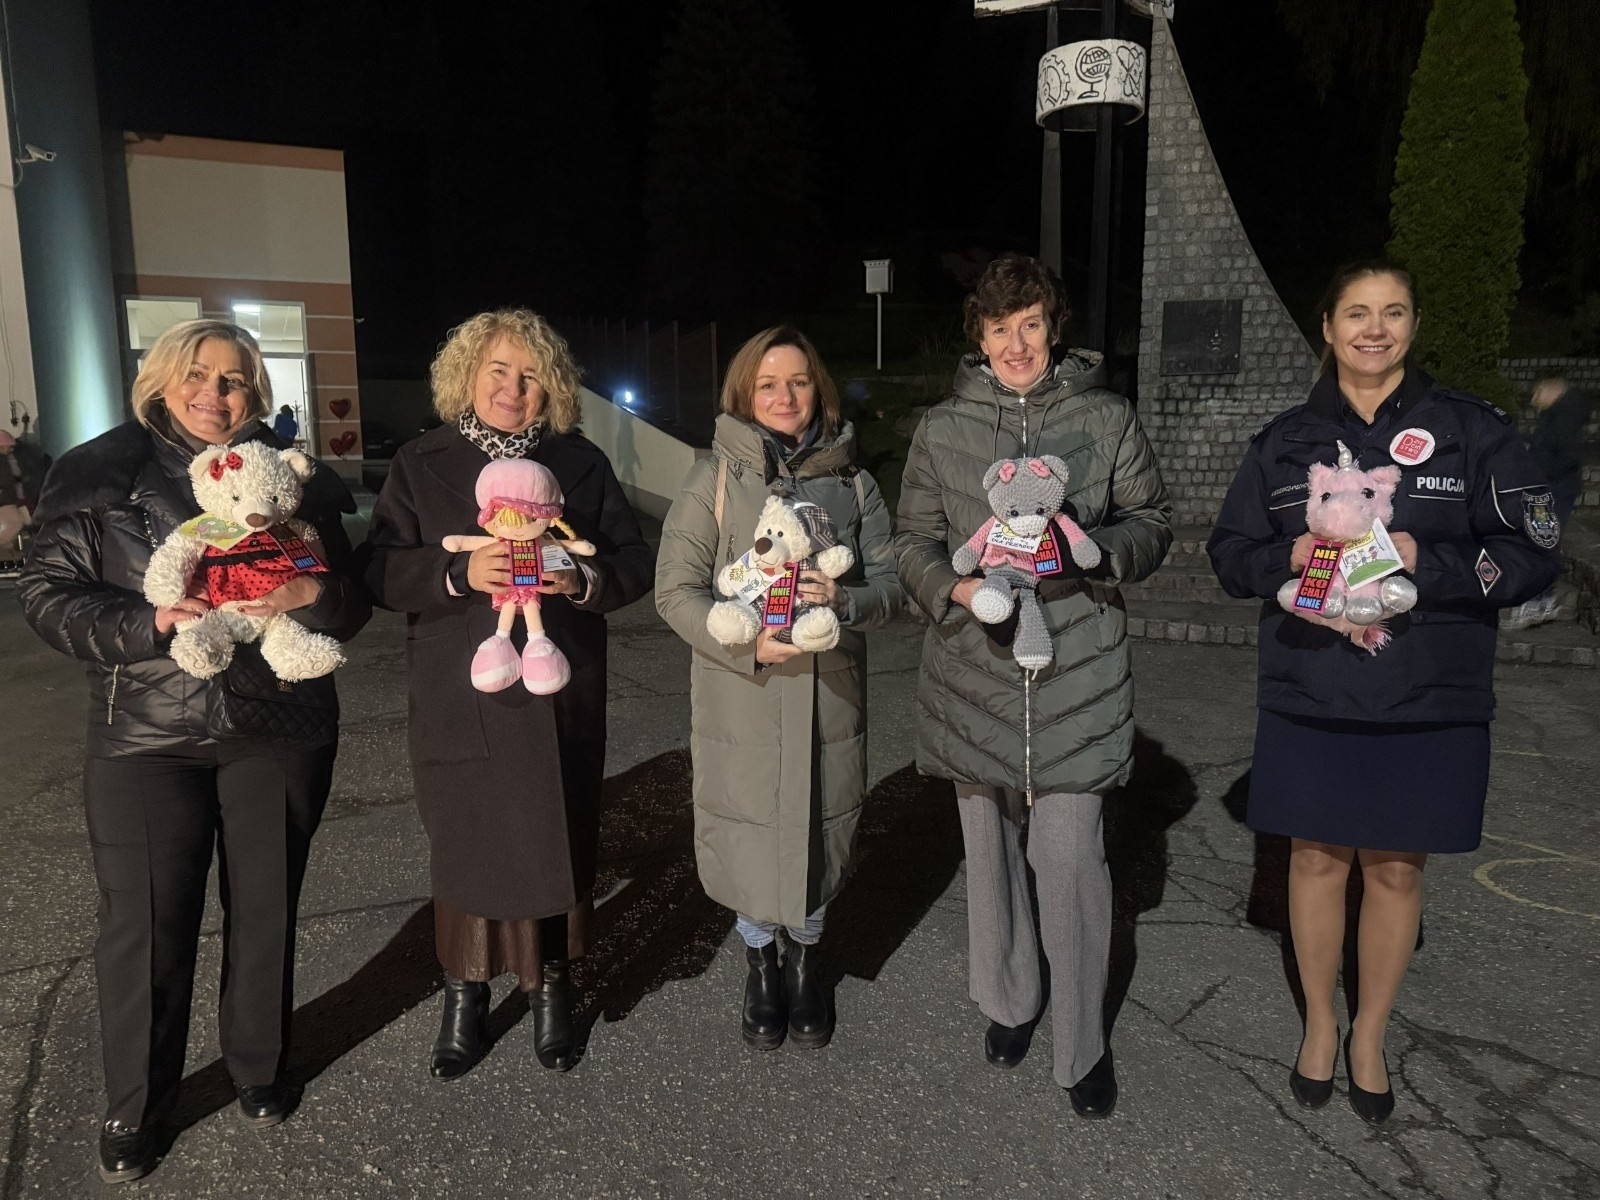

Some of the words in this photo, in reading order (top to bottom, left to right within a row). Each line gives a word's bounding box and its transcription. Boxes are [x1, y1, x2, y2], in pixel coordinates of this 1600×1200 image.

[1416, 476, 1465, 493] POLICJA
[281, 539, 303, 551] KO
[1314, 549, 1338, 560] NIE
[294, 556, 317, 570] MNIE
[1036, 560, 1057, 572] MNIE
[1311, 559, 1335, 570] BIJ
[514, 567, 537, 576] CHAJ
[1307, 568, 1333, 580] MNIE
[514, 576, 537, 585] MNIE
[1304, 578, 1328, 588] KO
[770, 587, 791, 596] MNIE
[1300, 587, 1326, 599] CHAJ
[769, 597, 789, 605] KO
[1297, 596, 1321, 609] MNIE
[767, 605, 788, 614] CHAJ
[766, 614, 787, 624] MNIE
